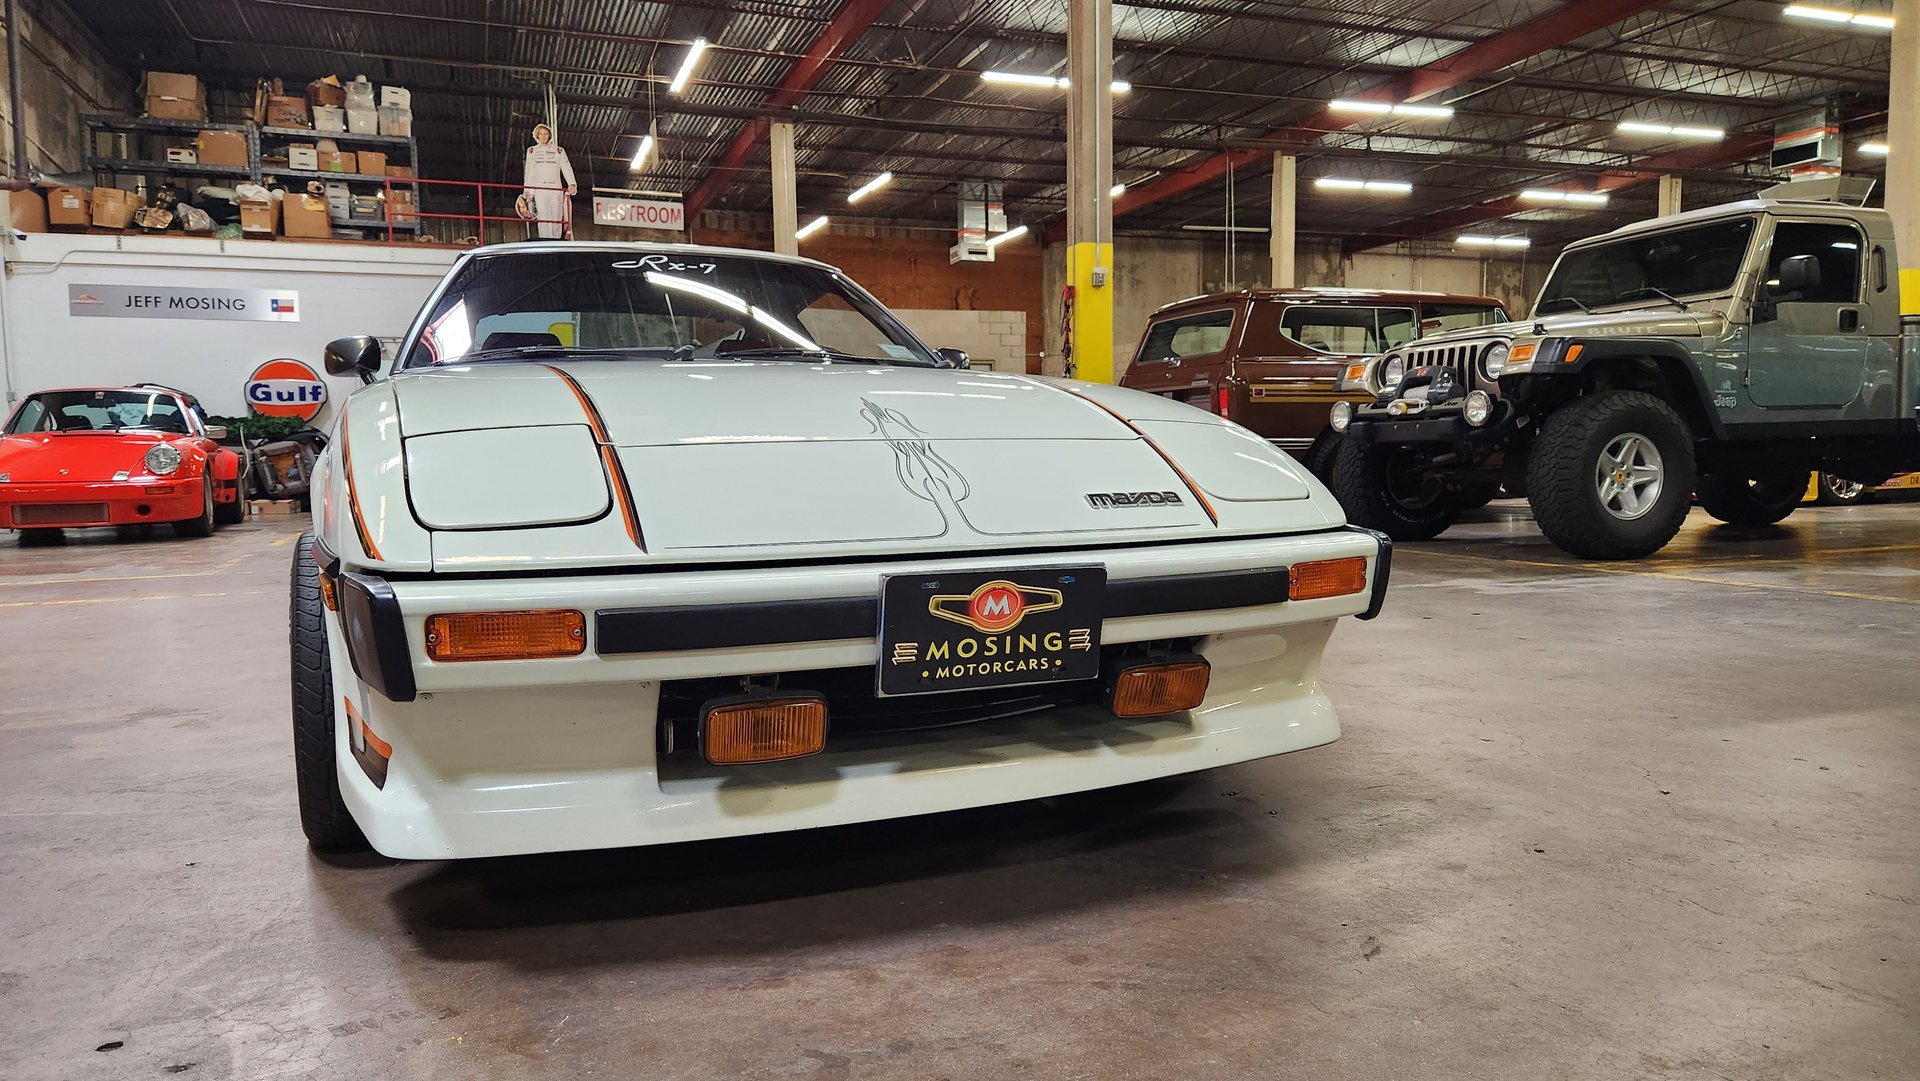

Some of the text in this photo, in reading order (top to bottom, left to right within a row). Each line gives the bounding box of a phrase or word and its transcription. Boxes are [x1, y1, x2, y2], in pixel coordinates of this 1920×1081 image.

[596, 202, 681, 224] RESTROOM
[125, 295, 246, 311] JEFF MOSING
[1587, 326, 1659, 335] BRUTE
[250, 383, 322, 402] Gulf
[1713, 394, 1737, 408] Jeep
[982, 594, 1012, 617] M
[925, 632, 1063, 661] MOSING
[935, 657, 1050, 679] MOTORCARS
